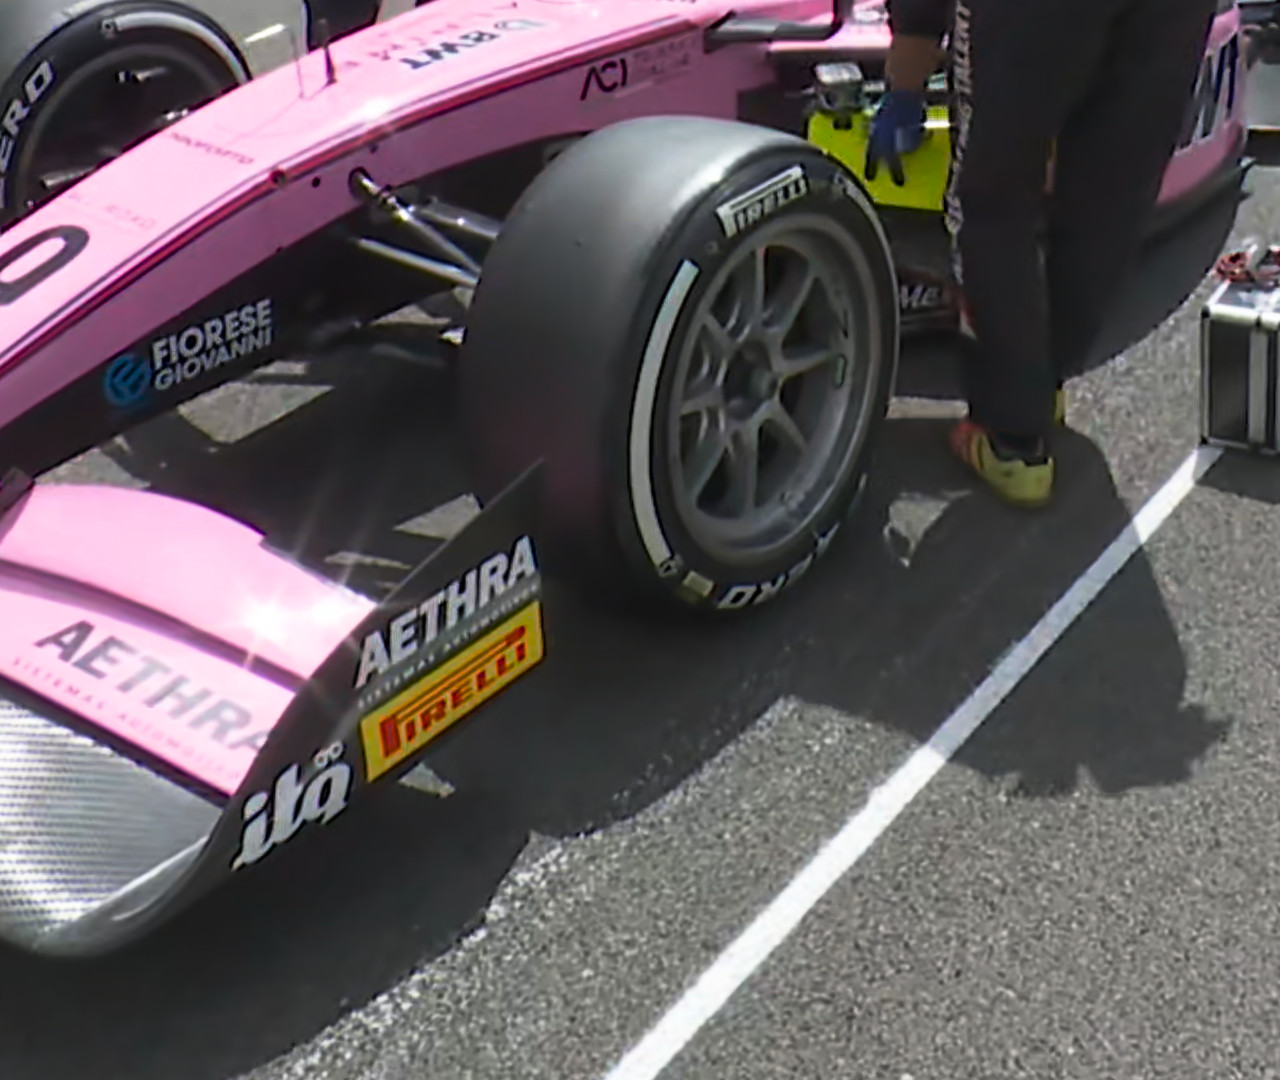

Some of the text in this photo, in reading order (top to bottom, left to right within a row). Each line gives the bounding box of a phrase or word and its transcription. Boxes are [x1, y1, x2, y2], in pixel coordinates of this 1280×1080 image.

[715, 163, 808, 239] PIRELLI
[152, 298, 272, 370] FIORESE
[154, 326, 272, 391] GIOVANNI
[355, 534, 539, 690] AETHRA
[379, 625, 527, 760] PIRELLI
